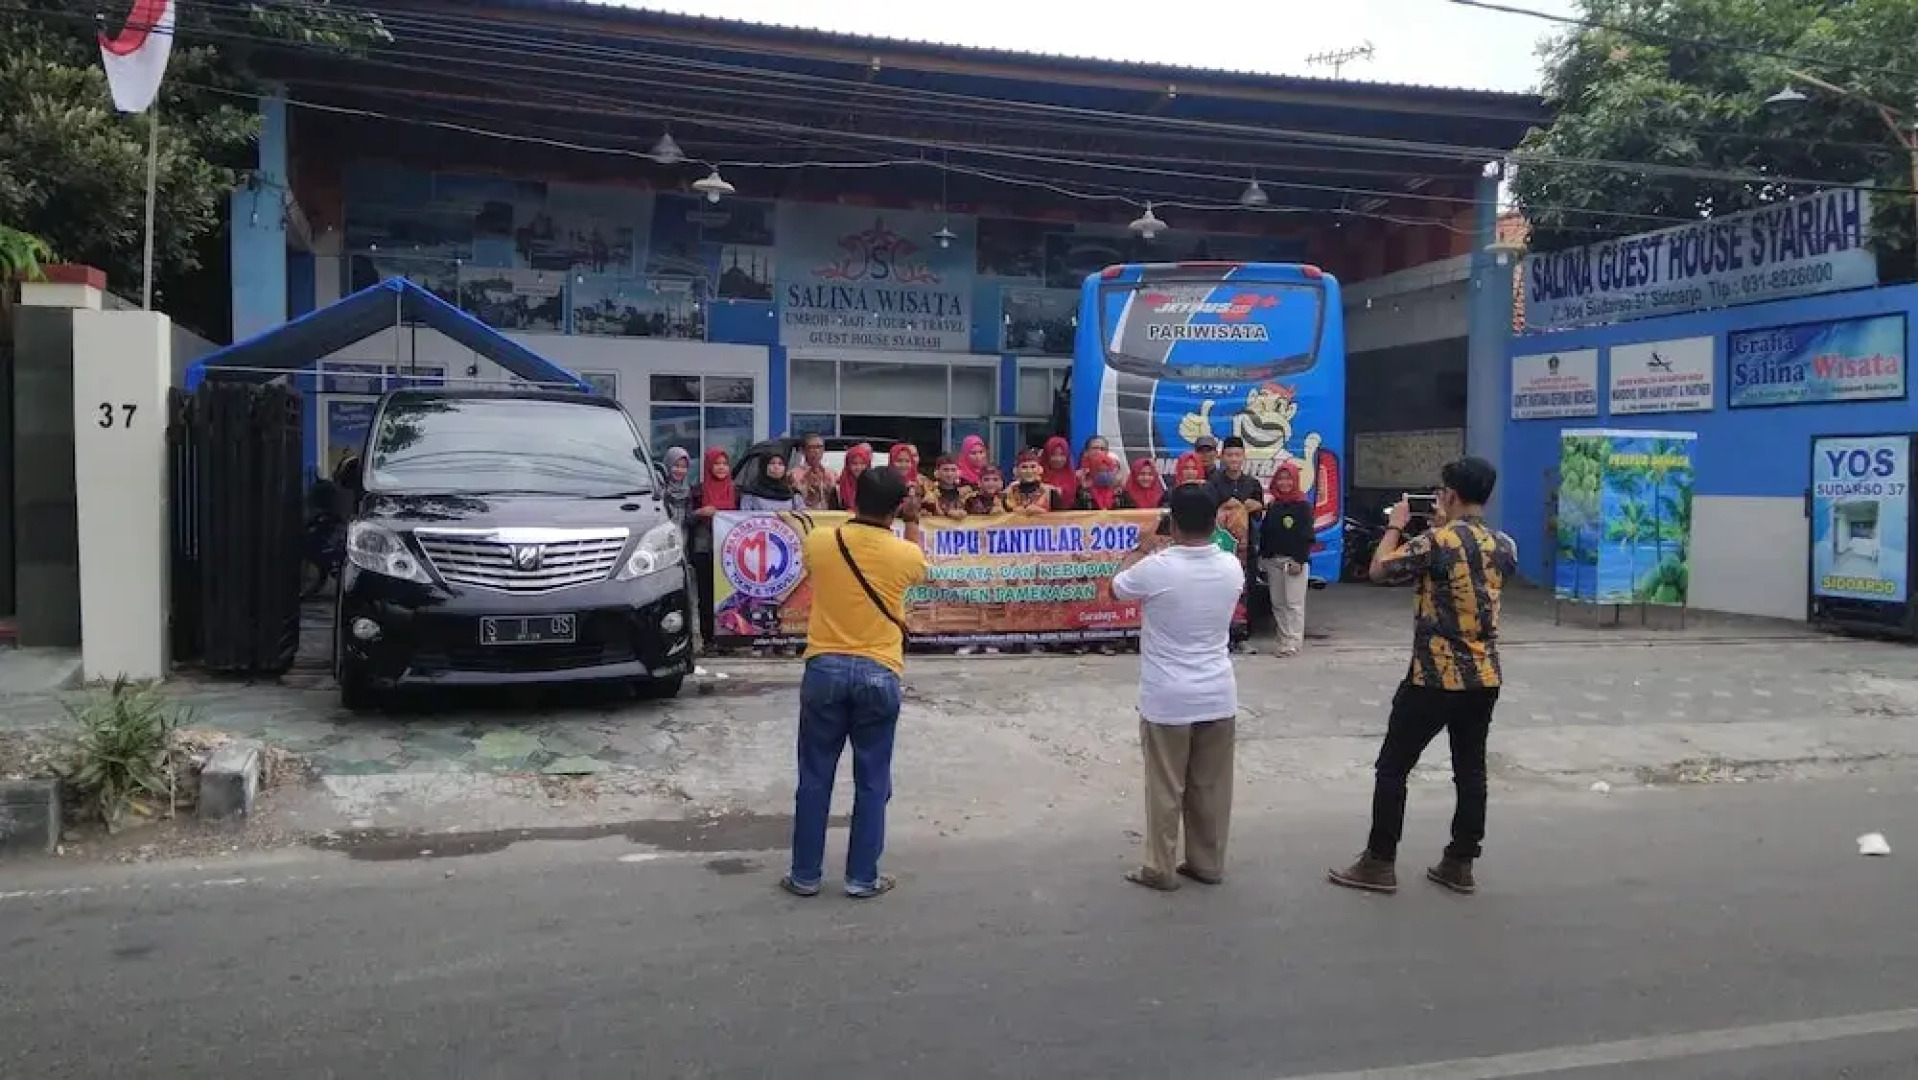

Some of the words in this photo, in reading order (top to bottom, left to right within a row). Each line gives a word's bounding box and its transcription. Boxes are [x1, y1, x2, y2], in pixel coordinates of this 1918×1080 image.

[1532, 250, 1594, 301] SALINA
[1600, 234, 1662, 293] GUEST
[1669, 217, 1743, 281] HOUSE
[1751, 189, 1862, 267] SYARIAH
[787, 284, 869, 311] SALINA
[875, 289, 962, 316] WISATA
[1651, 286, 1701, 307] Sidoarjo
[786, 312, 829, 326] UMROH
[921, 319, 966, 334] TRAVEL
[1149, 324, 1268, 341] PARIWISATA
[809, 331, 848, 345] GUEST
[851, 333, 890, 347] HOUSE
[892, 335, 942, 349] SYARIAH
[1736, 361, 1806, 387] Salina
[1812, 353, 1899, 379] Wisata
[99, 402, 137, 428] 37
[1826, 449, 1894, 478] YOS
[1817, 483, 1882, 496] SUDARSO
[1888, 483, 1905, 496] 37
[935, 530, 980, 555] MPU
[987, 526, 1083, 555] TANTULAR
[1090, 524, 1139, 551] 2018
[928, 566, 994, 580] IWISATA
[1000, 564, 1035, 579] DAN
[1040, 562, 1119, 578] KEBUDAY
[905, 585, 989, 601] ABUPATEN
[995, 583, 1096, 601] PAMEKASAN
